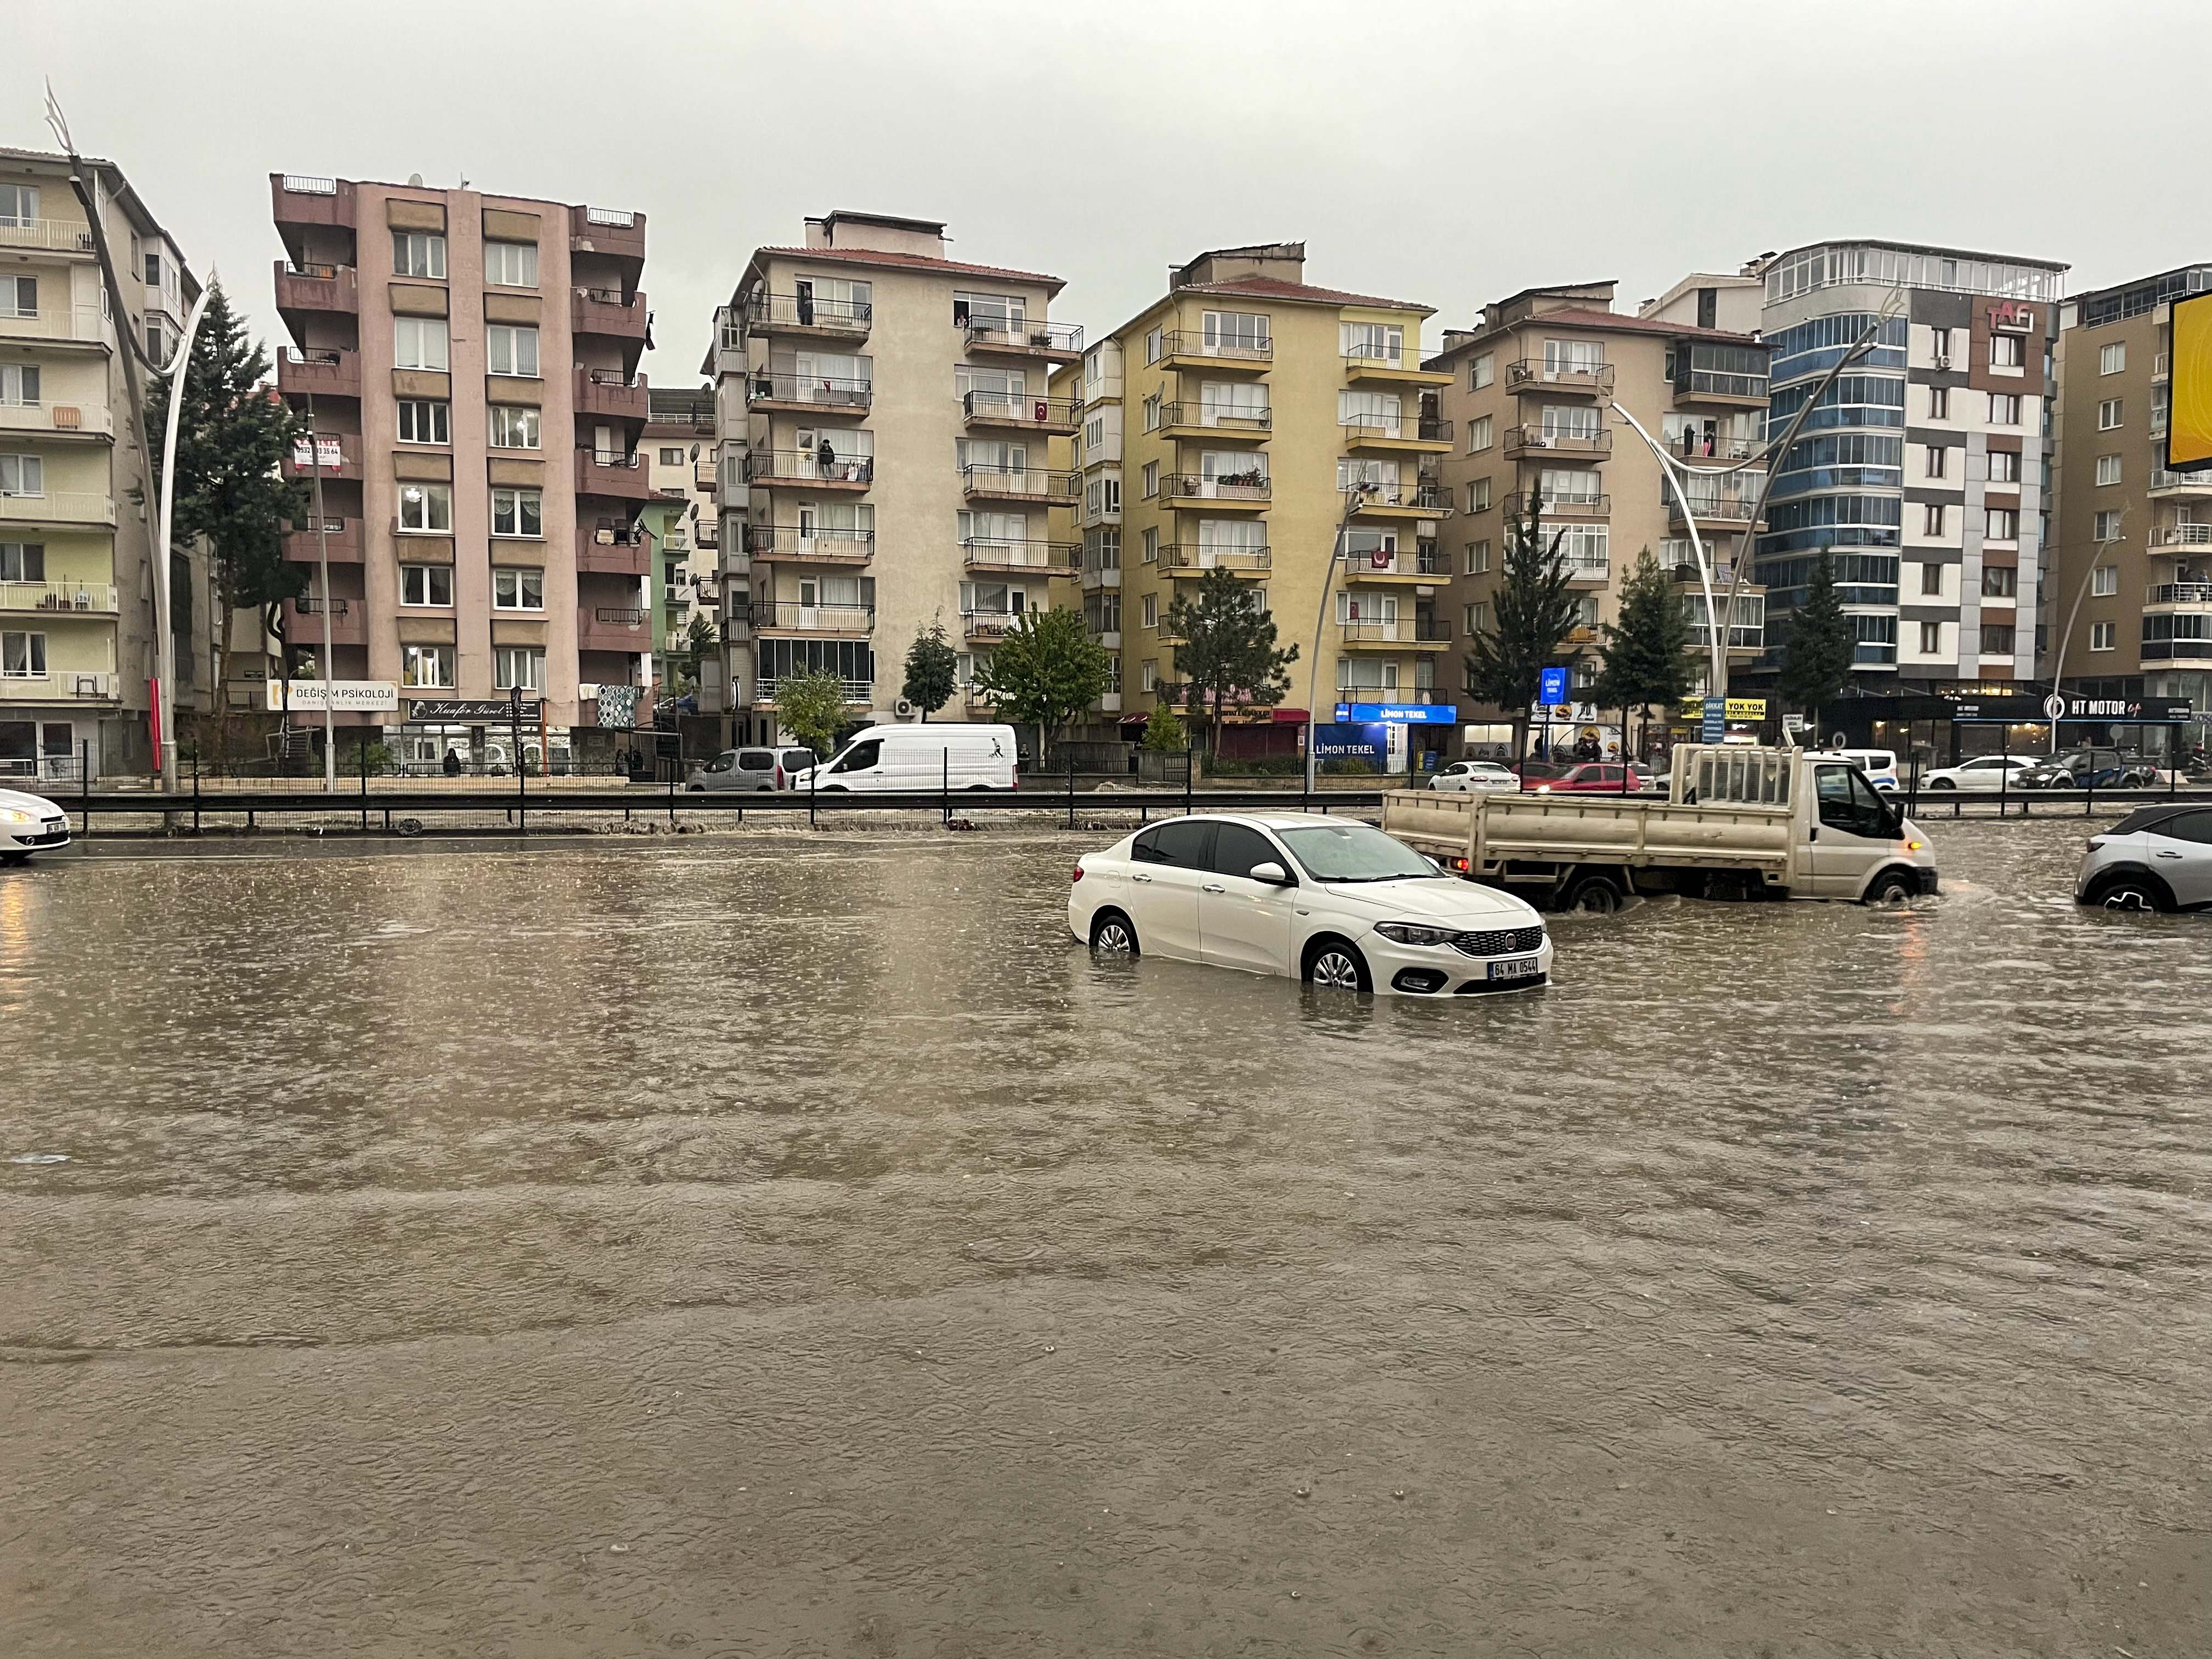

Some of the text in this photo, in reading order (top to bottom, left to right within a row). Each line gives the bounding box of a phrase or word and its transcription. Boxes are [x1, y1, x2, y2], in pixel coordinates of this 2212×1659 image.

[1545, 678, 1560, 687] LİMON
[296, 687, 393, 699] DEĞİŞM PSİKOLOJİ
[430, 703, 471, 718] Kuaför
[1381, 708, 1427, 719] LİMON TEKEL
[2072, 700, 2086, 715] HT
[2089, 700, 2125, 715] MOTOR
[1316, 743, 1375, 754] LİMON TEKEL
[1495, 960, 1536, 975] 64 MA 0544
